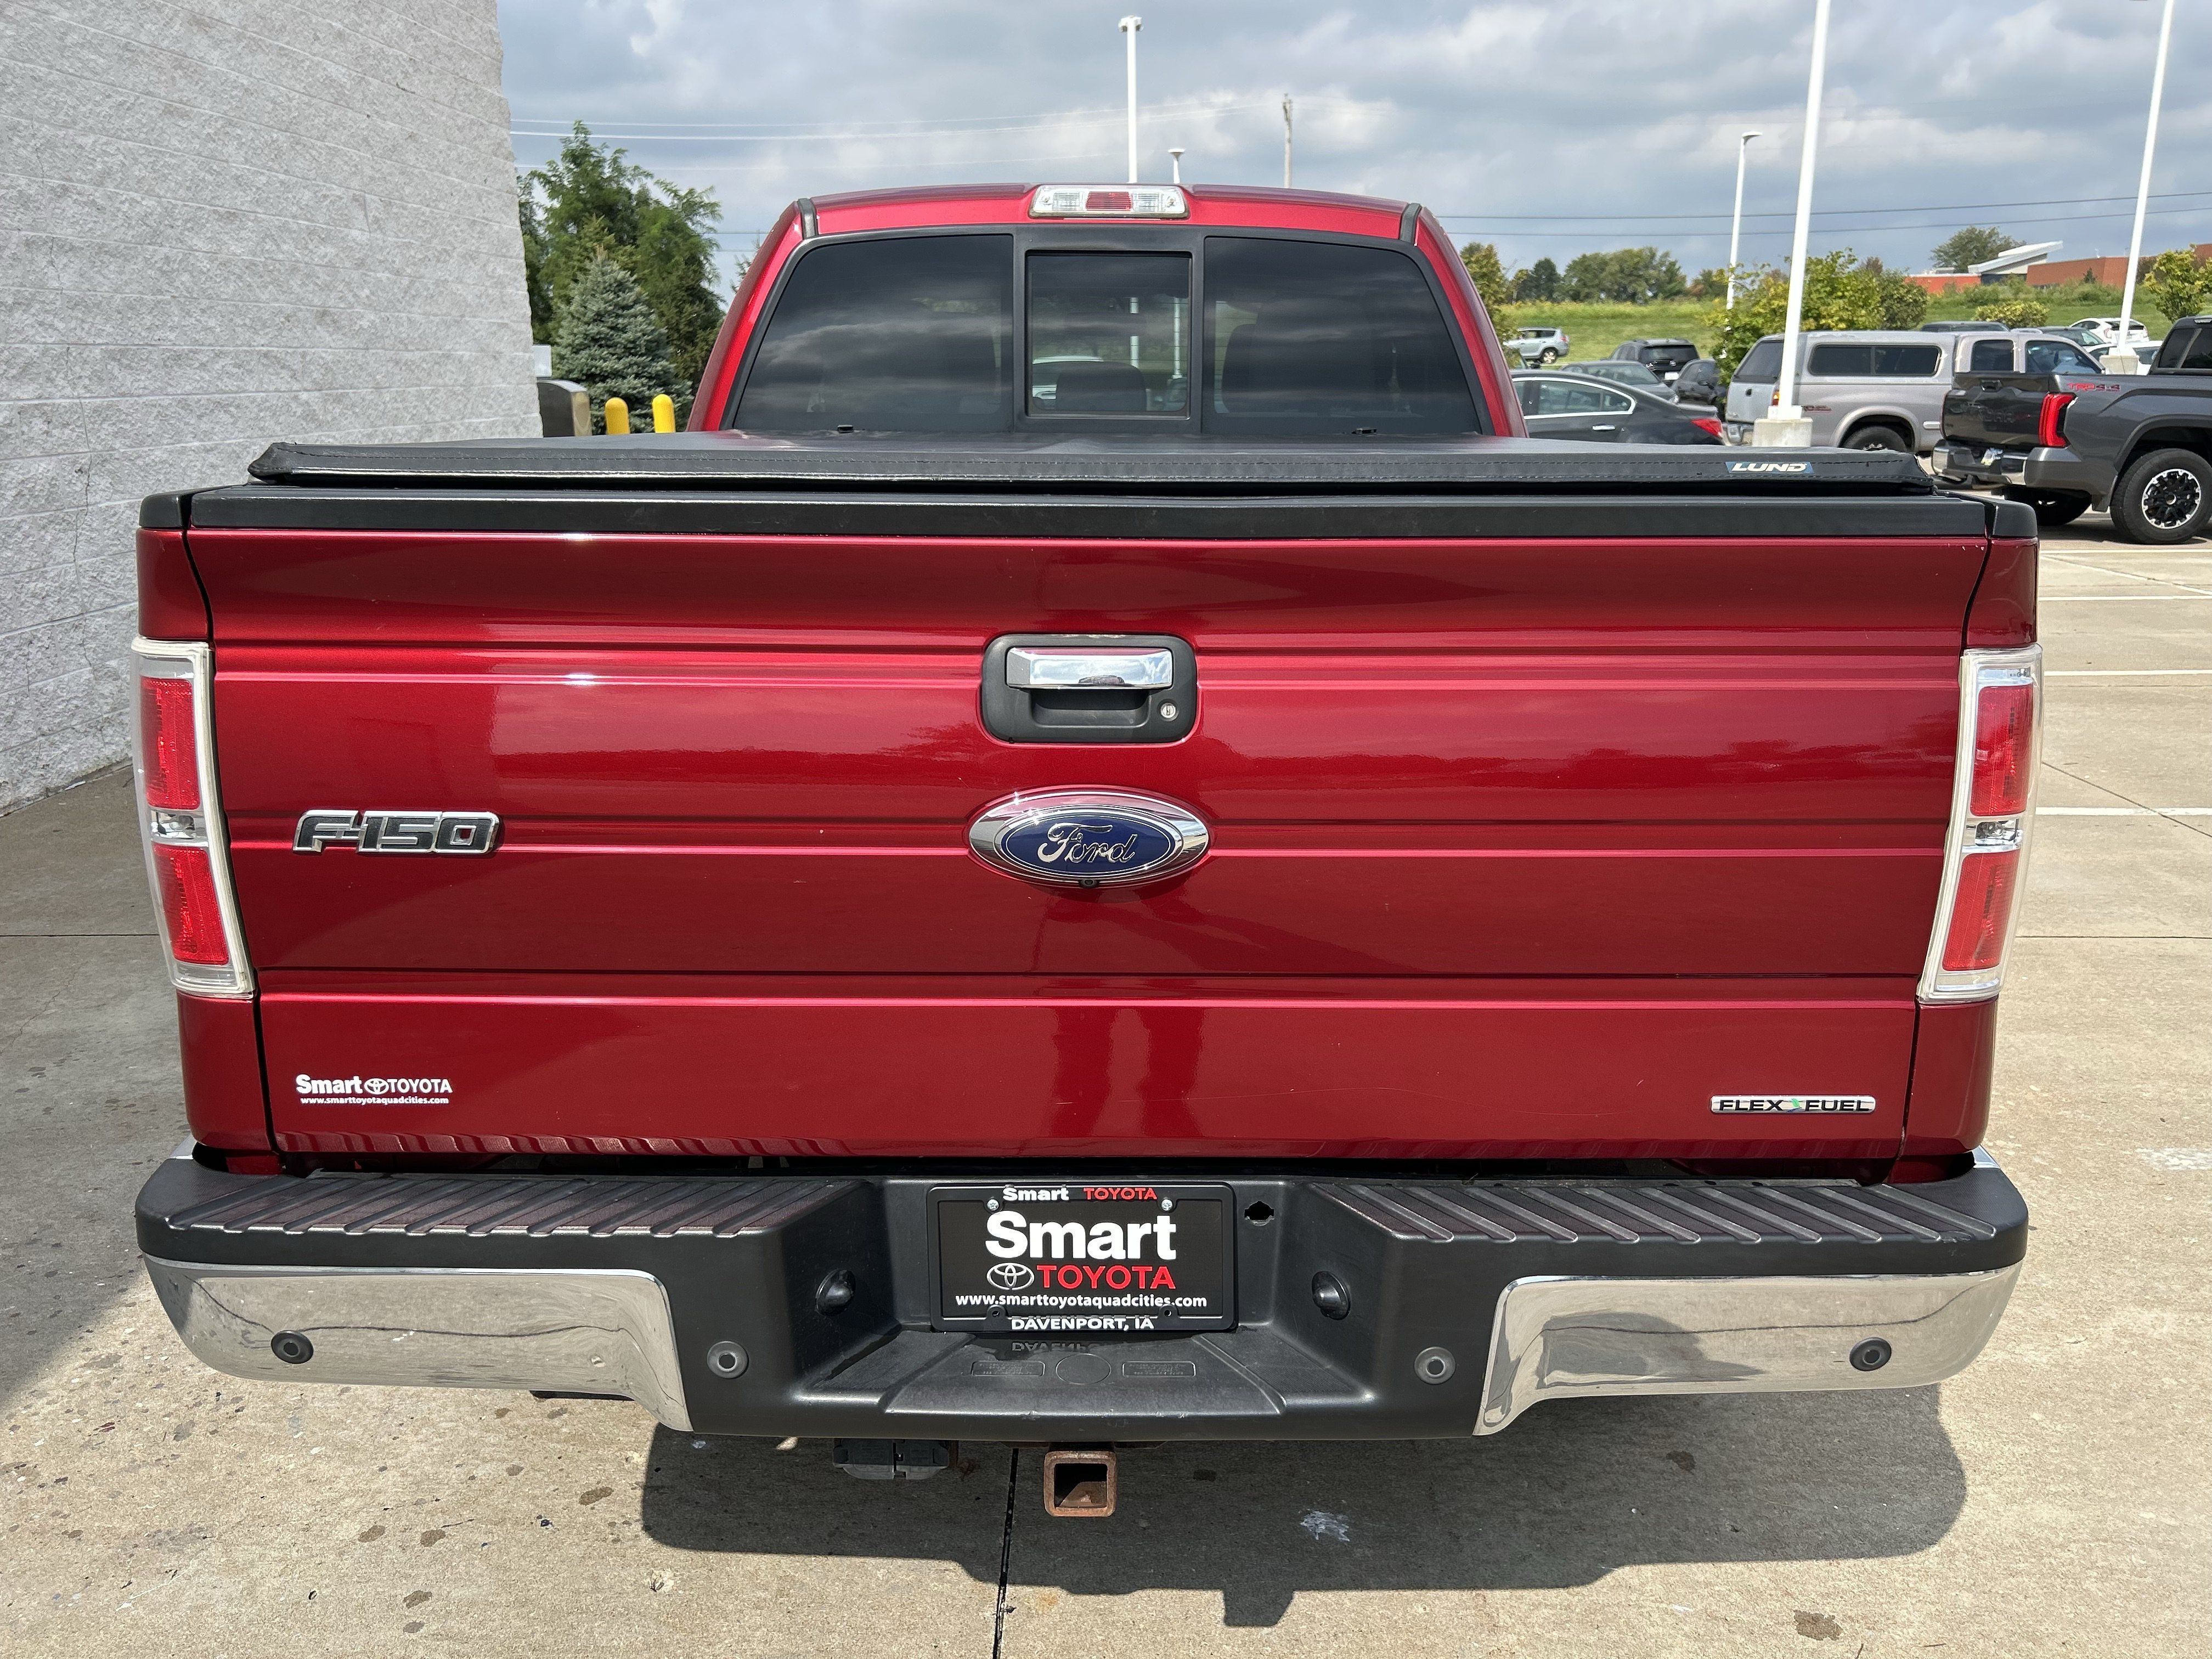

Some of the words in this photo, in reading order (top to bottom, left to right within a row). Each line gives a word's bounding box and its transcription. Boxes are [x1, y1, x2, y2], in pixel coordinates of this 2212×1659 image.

[1731, 463, 1807, 472] LUND
[292, 809, 500, 853] F-150
[1037, 822, 1138, 863] Ford
[295, 1074, 363, 1094] Smart
[387, 1079, 453, 1093] TOYOTA
[300, 1096, 449, 1105] www.smarttoyotaquadcities.com
[1719, 1099, 1784, 1111] FLEX
[1805, 1100, 1870, 1111] FUEL
[1003, 1187, 1069, 1201] Smart
[1083, 1187, 1158, 1200] TOYOTA
[985, 1210, 1177, 1260] Smart
[1036, 1265, 1176, 1290] TOYOTA
[955, 1294, 1207, 1308] www.smarttoyotaquadcities.com
[1011, 1317, 1129, 1331] DAVENPORT,
[1135, 1318, 1155, 1330] IA
